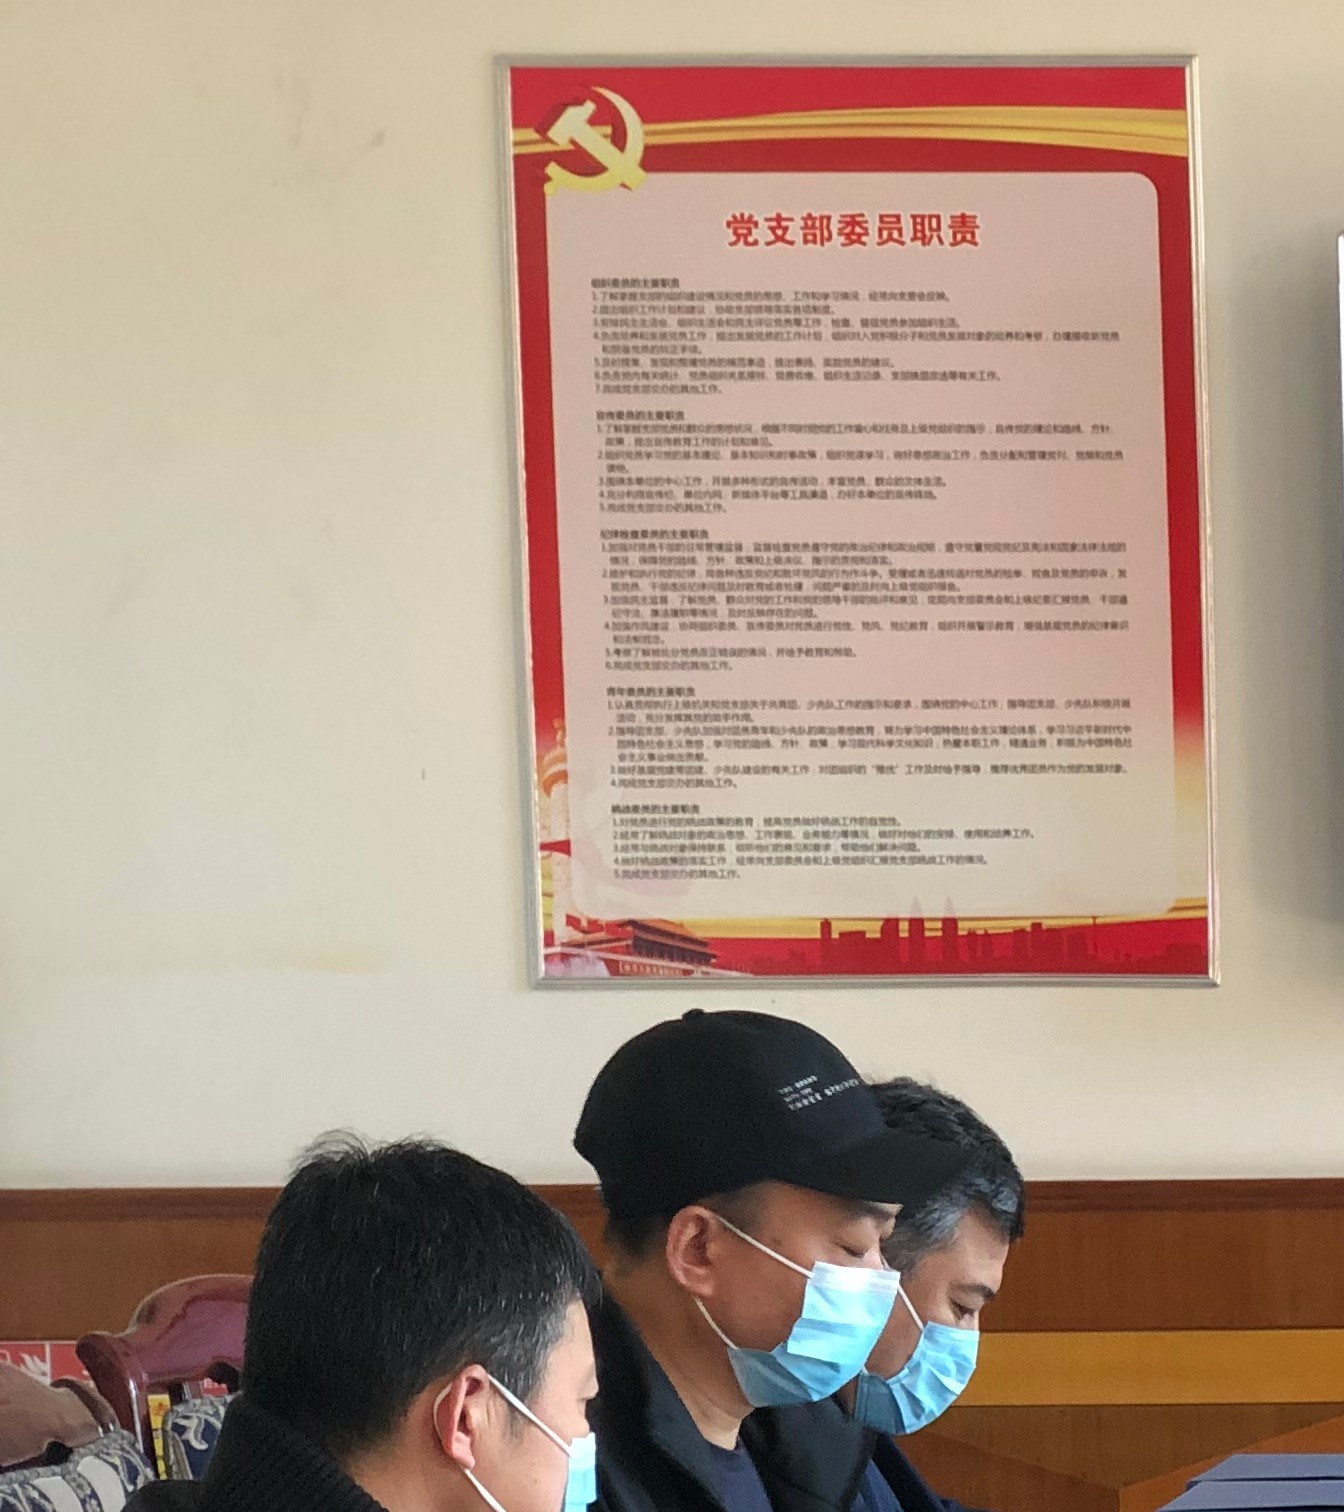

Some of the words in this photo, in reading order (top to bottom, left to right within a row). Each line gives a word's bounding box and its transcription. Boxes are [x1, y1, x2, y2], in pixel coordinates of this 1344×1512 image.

[726, 213, 981, 247] 党支部委员职责
